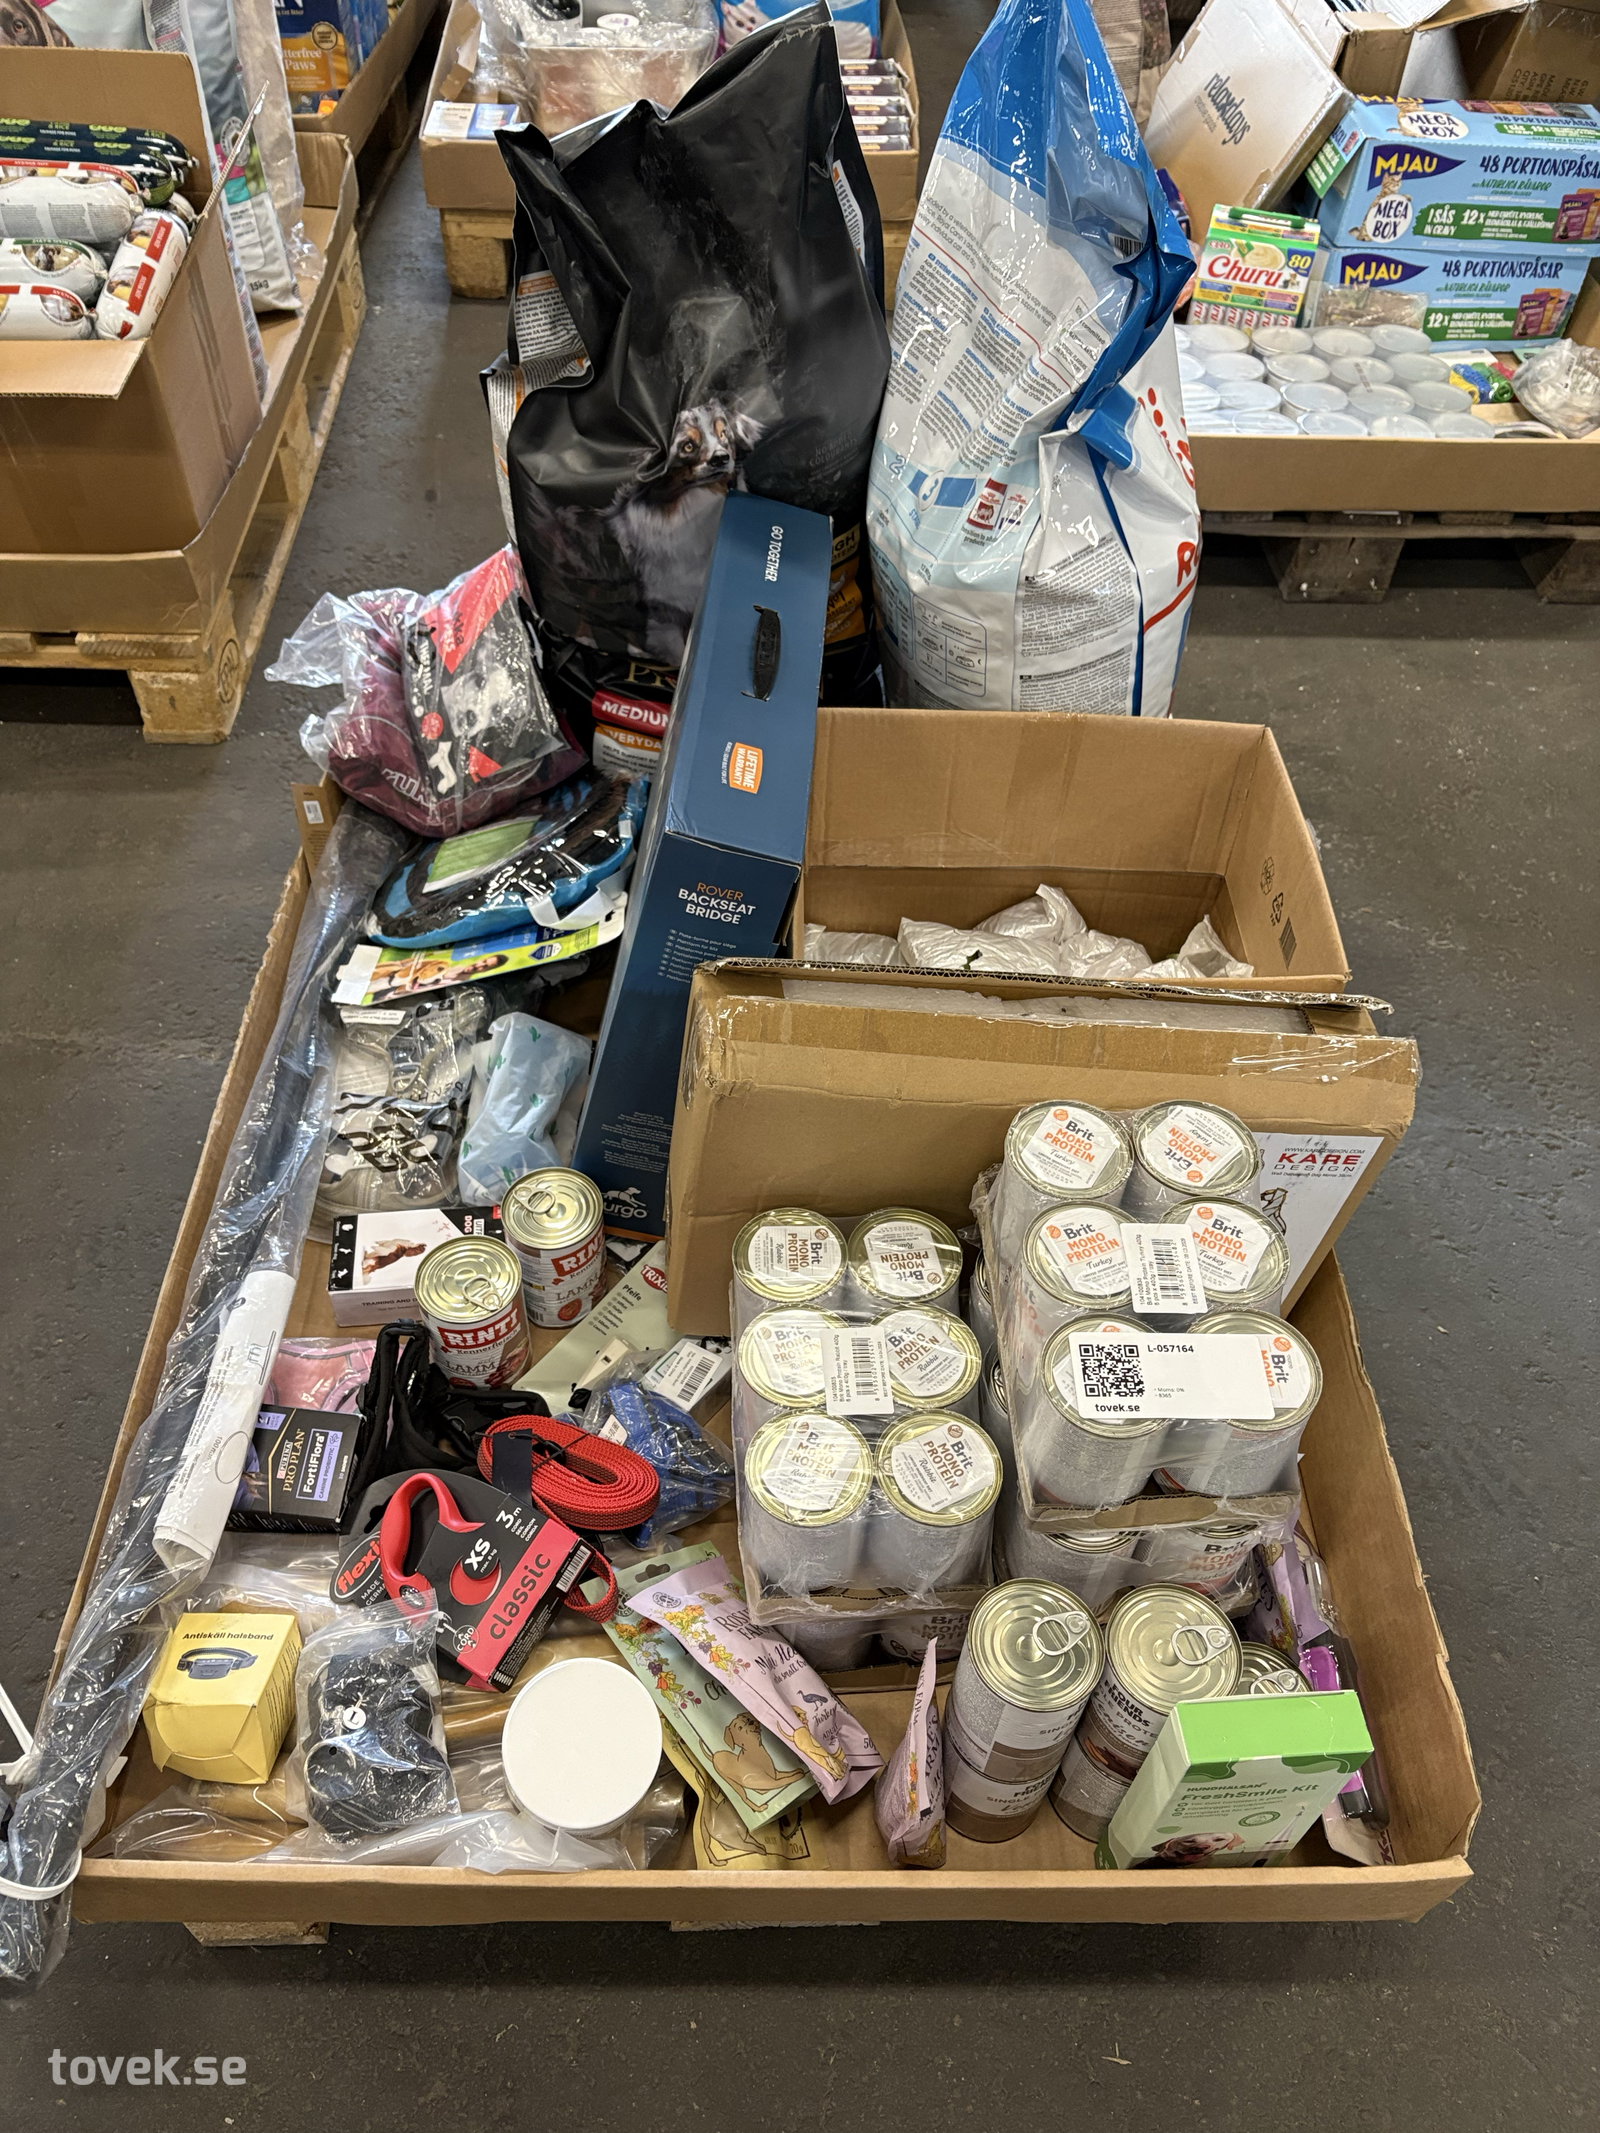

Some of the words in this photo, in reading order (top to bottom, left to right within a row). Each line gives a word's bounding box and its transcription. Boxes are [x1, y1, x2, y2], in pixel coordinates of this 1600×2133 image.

[282, 48, 322, 58] tterfree
[284, 60, 317, 71] Paws
[1203, 73, 1251, 146] relaxdays
[1408, 114, 1460, 127] MEGA
[1419, 126, 1460, 139] BOX
[1374, 152, 1438, 178] MJAU
[1480, 154, 1501, 173] 48
[1502, 154, 1600, 180] PORTIONSPÅSA
[1480, 178, 1517, 190] NATURLIGA
[1518, 178, 1552, 192] RÅVAROR
[1374, 199, 1409, 220] MEGA
[1428, 208, 1435, 223] I
[1435, 204, 1456, 224] SÅS
[1461, 208, 1478, 225] 12
[1478, 213, 1486, 224] x
[1372, 220, 1401, 240] BOX
[1424, 225, 1432, 234] IN
[1432, 225, 1458, 236] GRAVY
[1208, 255, 1284, 287] Churu
[1288, 254, 1312, 270] 80
[1344, 261, 1404, 284] MJAU
[1442, 260, 1460, 277] 48
[1463, 256, 1564, 280] PORTIONSPÅSAR
[1426, 313, 1442, 328] 12
[1442, 316, 1450, 326] x
[772, 524, 784, 540] GO
[733, 748, 746, 786] WARRANTY
[743, 749, 759, 789] LIFETIME
[678, 888, 756, 916] BACKSEAT
[696, 882, 744, 902] ROVER
[686, 903, 742, 925] BRIDGE
[1054, 1127, 1093, 1152] MONO
[1065, 1120, 1095, 1142] Brit
[1190, 1128, 1213, 1148] Turkey
[1044, 1132, 1096, 1164] PROTEIN
[1168, 1126, 1217, 1162] PROTEIN
[1168, 1138, 1204, 1164] MONO
[1050, 1148, 1076, 1166] Turkey
[1164, 1146, 1193, 1171] Brit
[1274, 1164, 1356, 1172] DESIGN
[1278, 1152, 1362, 1166] KARE
[602, 1202, 648, 1219] urgo
[464, 1215, 472, 1234] DOG
[1066, 1223, 1096, 1240] Brit
[1212, 1218, 1244, 1239] Brit
[1067, 1232, 1107, 1251] MONO
[1192, 1232, 1248, 1263] PROTEIN
[1202, 1227, 1244, 1250] MONO
[558, 1238, 602, 1272] RIN
[775, 1242, 785, 1264] Rabbit
[788, 1232, 800, 1273] PROTEIN
[798, 1238, 810, 1268] MONO
[810, 1242, 823, 1264] Brit
[880, 1250, 930, 1263] PROTEIN
[1066, 1238, 1120, 1264] PROTEIN
[1200, 1248, 1227, 1267] Turkey
[890, 1261, 926, 1271] MONO
[1085, 1256, 1114, 1271] Turkey
[622, 1284, 642, 1302] Pfeife
[444, 1307, 519, 1348] RINTI
[887, 1327, 916, 1348] Brit
[775, 1336, 812, 1353] MONO
[894, 1332, 926, 1359] MONO
[898, 1336, 940, 1370] PROTEIN
[1146, 1344, 1194, 1354] L-057164
[445, 1362, 497, 1374] LAMM
[916, 1354, 940, 1373] Rabbit
[1272, 1354, 1289, 1384] Brit
[1094, 1403, 1141, 1412] tovek.se
[282, 1440, 292, 1472] PURINA
[288, 1430, 306, 1464] PLAN
[950, 1440, 974, 1468] Brit
[322, 1446, 336, 1476] PROBIOTIC
[786, 1449, 836, 1479] PROTEIN
[918, 1457, 936, 1485] Rabbit
[922, 1440, 960, 1490] PROTEIN
[936, 1442, 965, 1478] MONO
[284, 1465, 296, 1493] PRO
[318, 1476, 328, 1499] CANINE
[496, 1510, 514, 1528] 3
[513, 1507, 522, 1516] m
[511, 1518, 522, 1532] CORD
[520, 1518, 536, 1538] CORDON
[525, 1525, 538, 1542] CORDA
[464, 1538, 491, 1572] XS
[338, 1540, 380, 1594] flexi
[360, 1578, 381, 1600] MADE
[366, 1583, 386, 1606] GERMA
[489, 1553, 552, 1641] classic
[182, 1632, 226, 1640] Antiskäll
[226, 1632, 274, 1641] halsband
[456, 1626, 476, 1652] CORD
[912, 1692, 924, 1726] FARM
[1104, 1680, 1152, 1728] FRIENDS
[1113, 1682, 1144, 1716] FOUR
[813, 1705, 838, 1727] Turkey
[1181, 1788, 1288, 1801] FreshSmile
[1291, 1784, 1320, 1793] Kit
